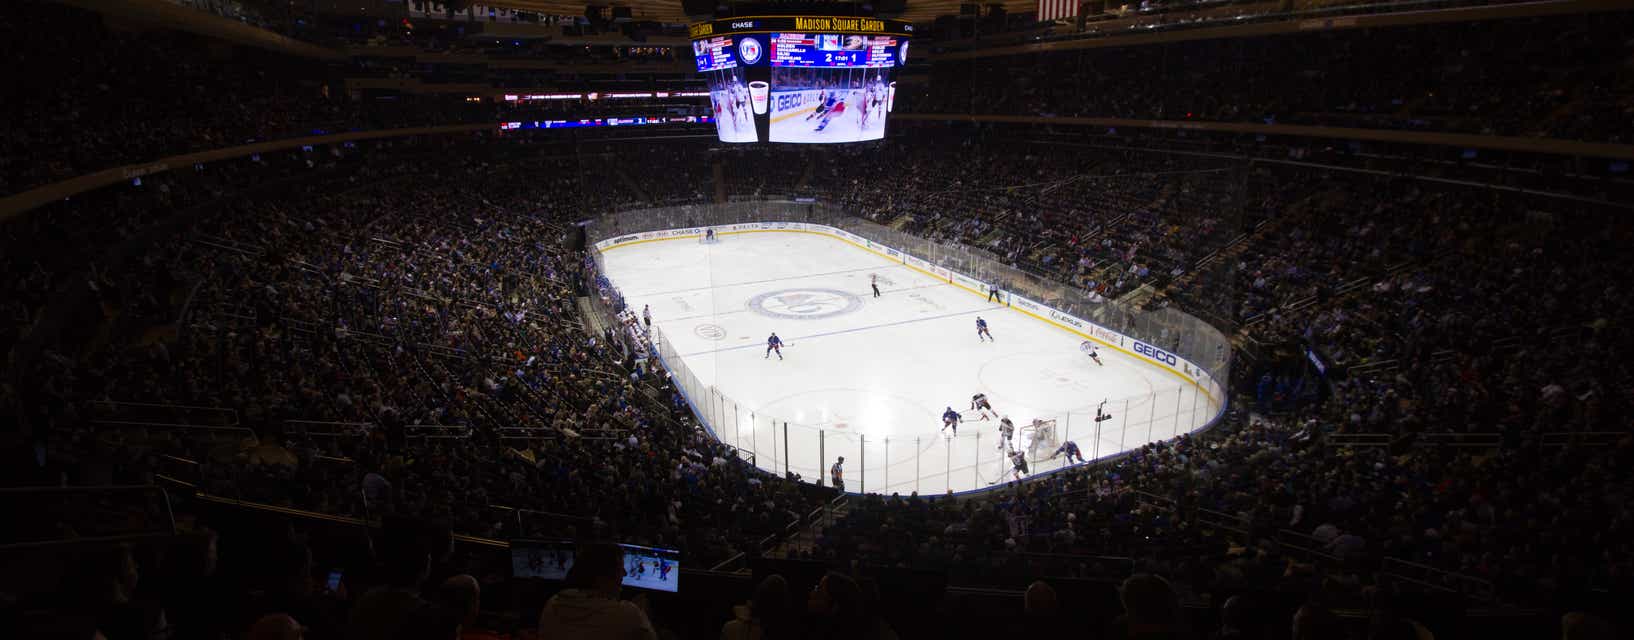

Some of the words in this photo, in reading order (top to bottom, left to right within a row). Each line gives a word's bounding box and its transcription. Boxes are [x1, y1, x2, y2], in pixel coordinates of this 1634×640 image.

[731, 21, 753, 29] CHASE
[795, 17, 831, 30] MADISON
[832, 17, 859, 31] SQUARE
[861, 18, 885, 31] GARDEN
[825, 53, 832, 62] 2
[851, 53, 857, 62] 1
[778, 93, 802, 112] GEICO
[1133, 341, 1177, 367] GEICO
